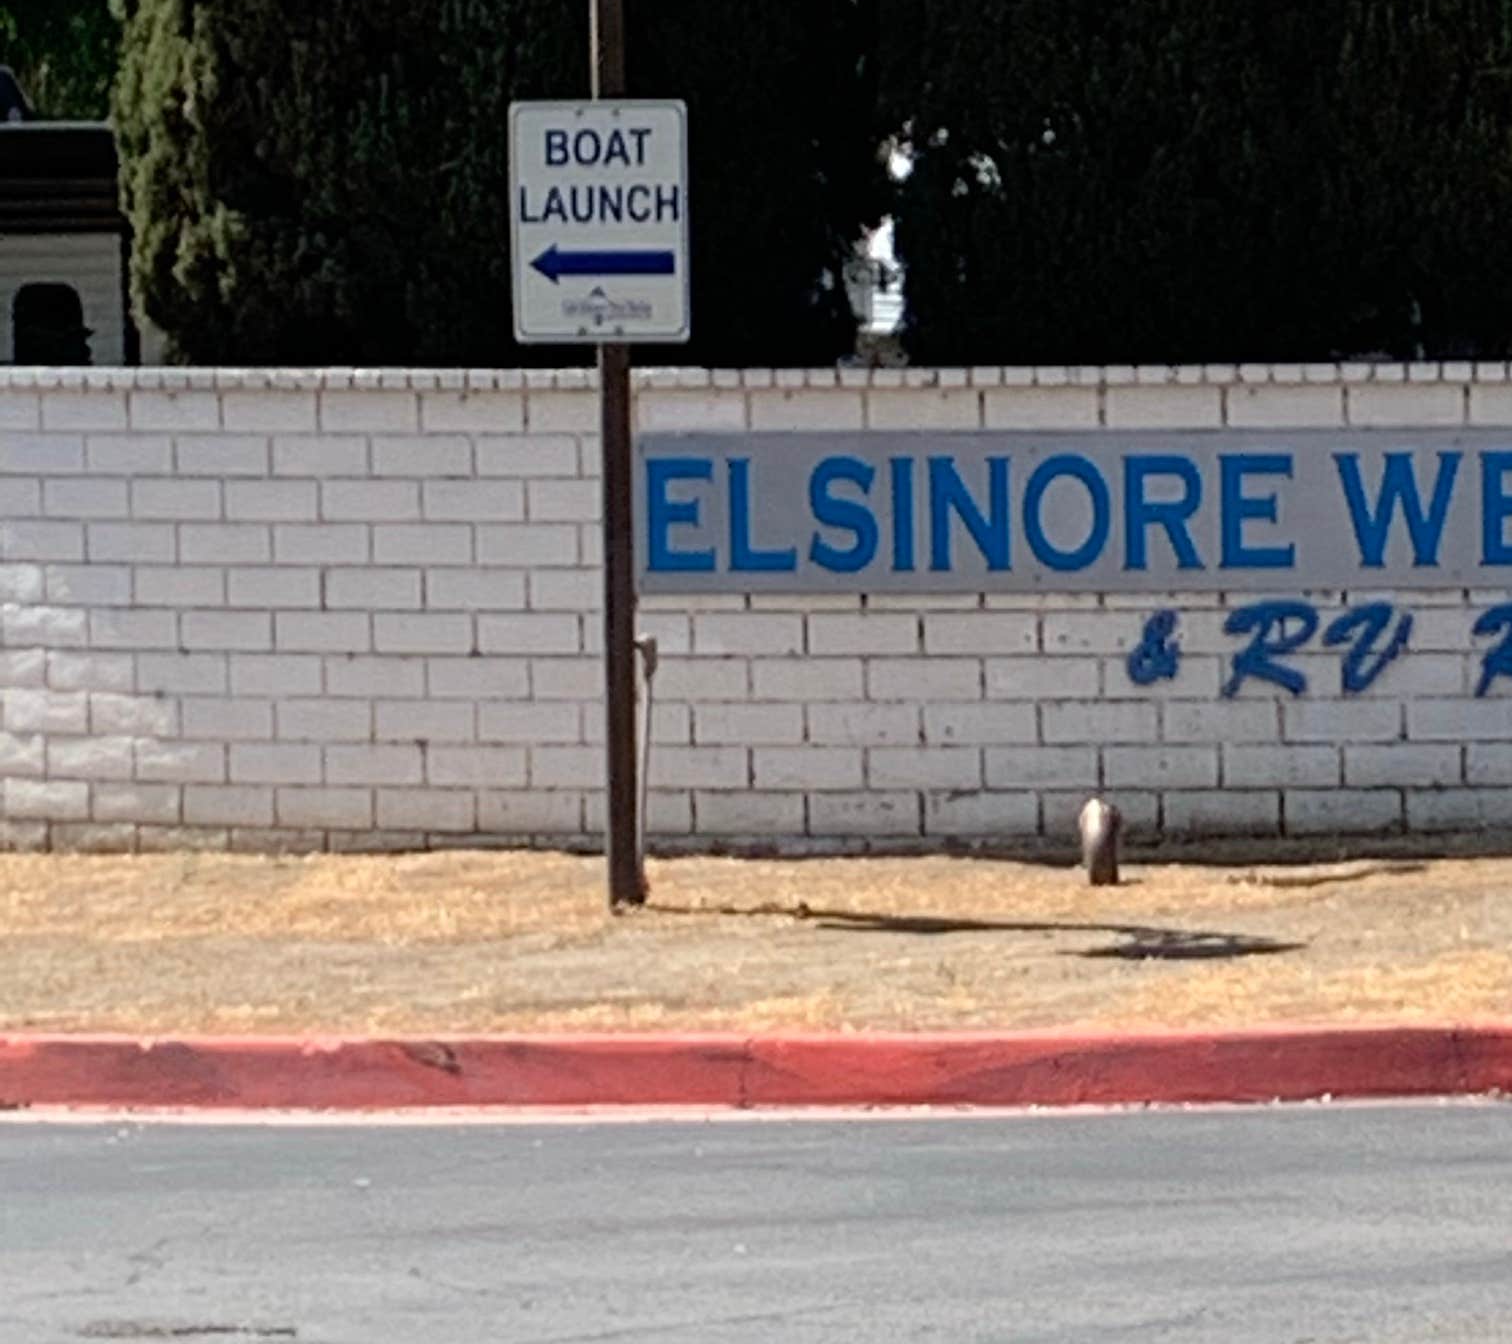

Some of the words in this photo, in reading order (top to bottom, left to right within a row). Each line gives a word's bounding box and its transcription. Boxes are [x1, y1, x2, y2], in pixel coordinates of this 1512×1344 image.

[545, 128, 652, 167] BOAT
[519, 184, 680, 224] LAUNCH
[645, 453, 1296, 573] ELSINORE
[1127, 611, 1180, 686] &
[1224, 599, 1413, 698] RV
